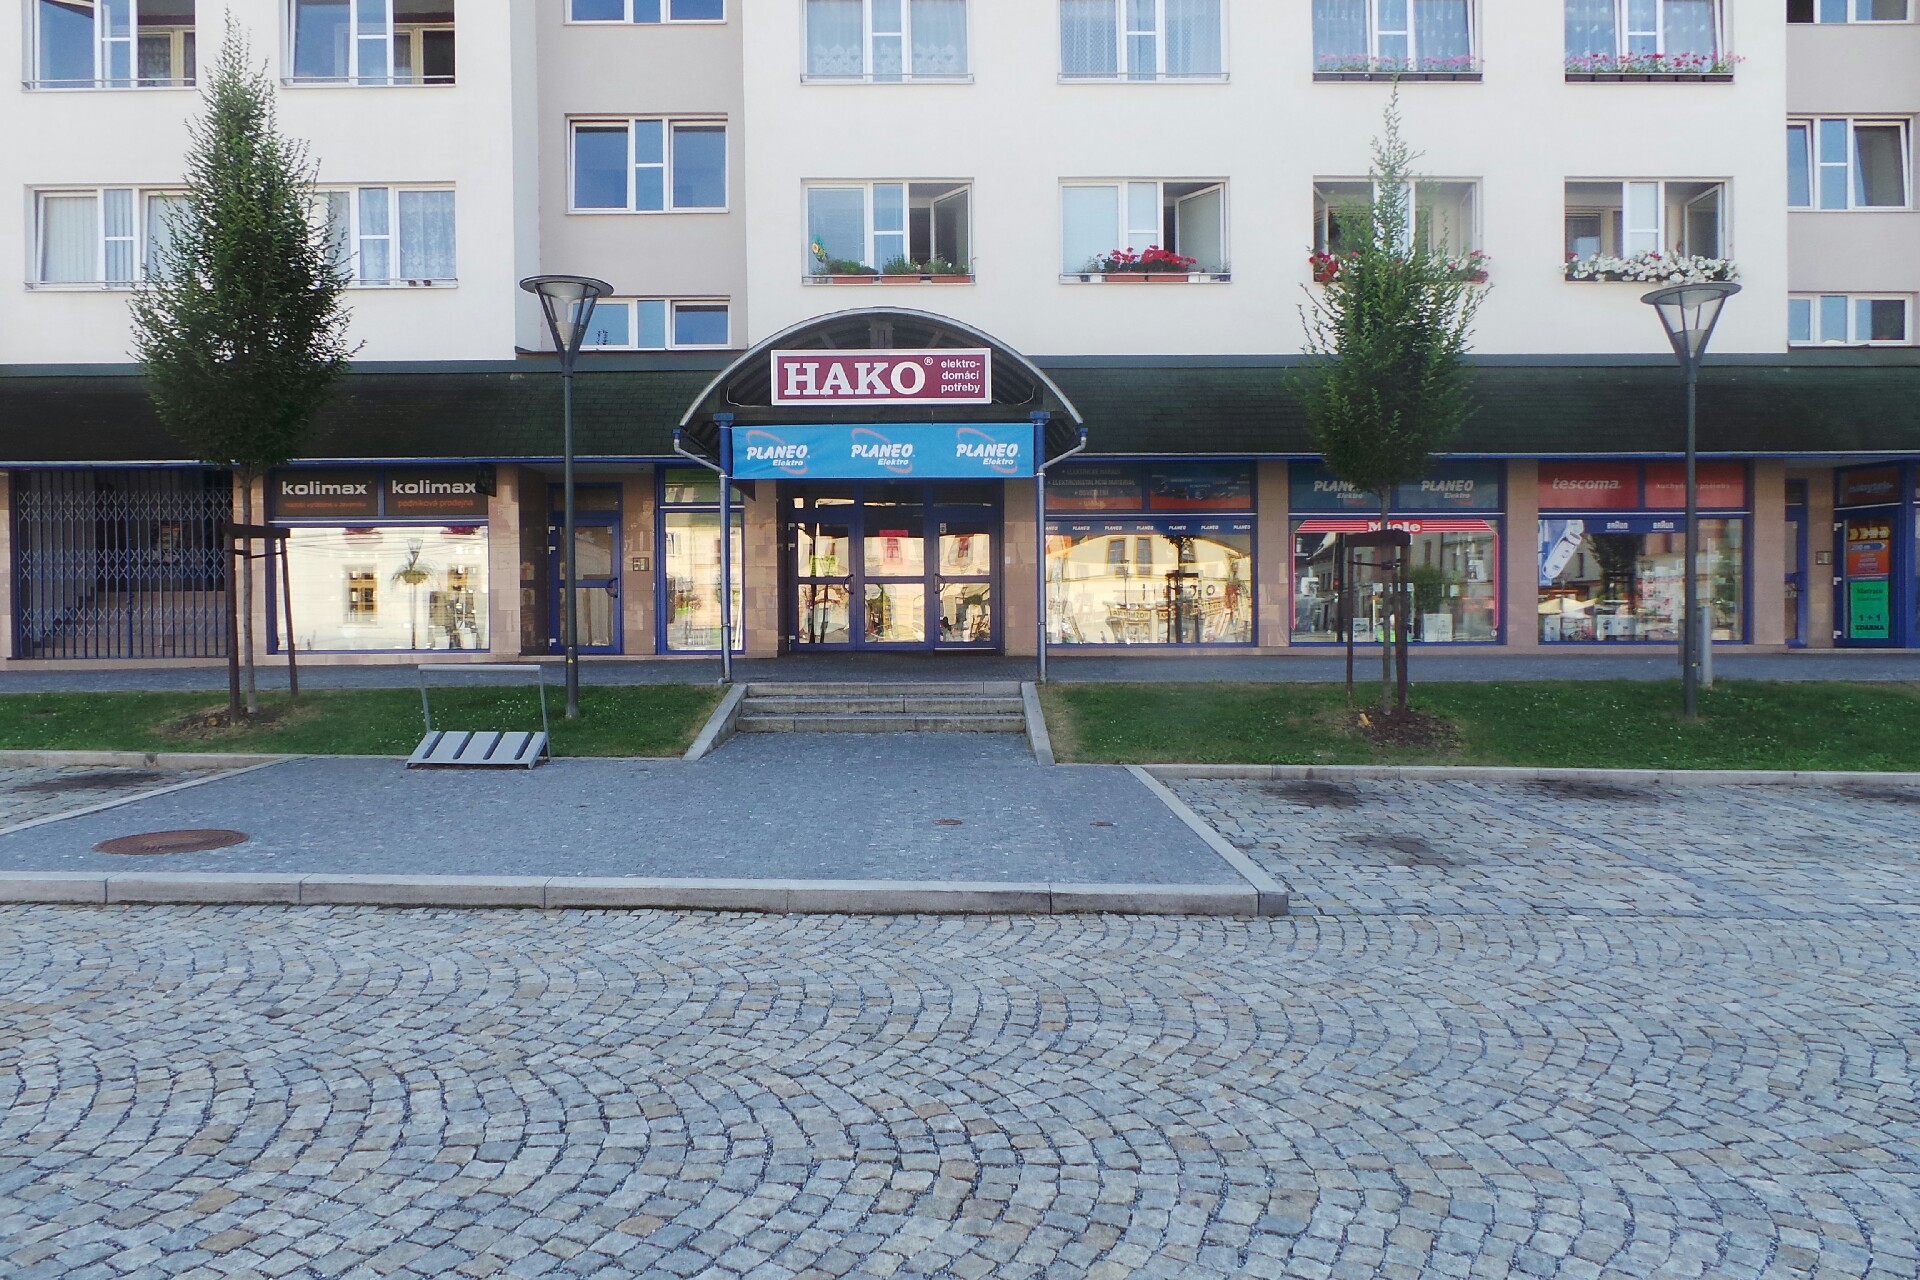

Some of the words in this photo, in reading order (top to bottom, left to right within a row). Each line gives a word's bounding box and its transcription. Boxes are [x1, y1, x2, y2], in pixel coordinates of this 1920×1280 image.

[940, 358, 981, 368] elektro-
[784, 361, 926, 395] HAKO
[942, 370, 979, 380] domácí
[940, 383, 981, 394] potřeby
[746, 444, 808, 460] PLANEO
[851, 443, 913, 458] PLANEO
[956, 443, 1018, 458] PLANEO
[772, 459, 804, 467] Elektro
[877, 458, 909, 466] Elektro
[983, 458, 1014, 466] Elektro
[282, 481, 368, 495] kolimax
[392, 480, 477, 494] kolimax
[1421, 480, 1473, 492] PLANEO
[1552, 477, 1620, 490] tescoma
